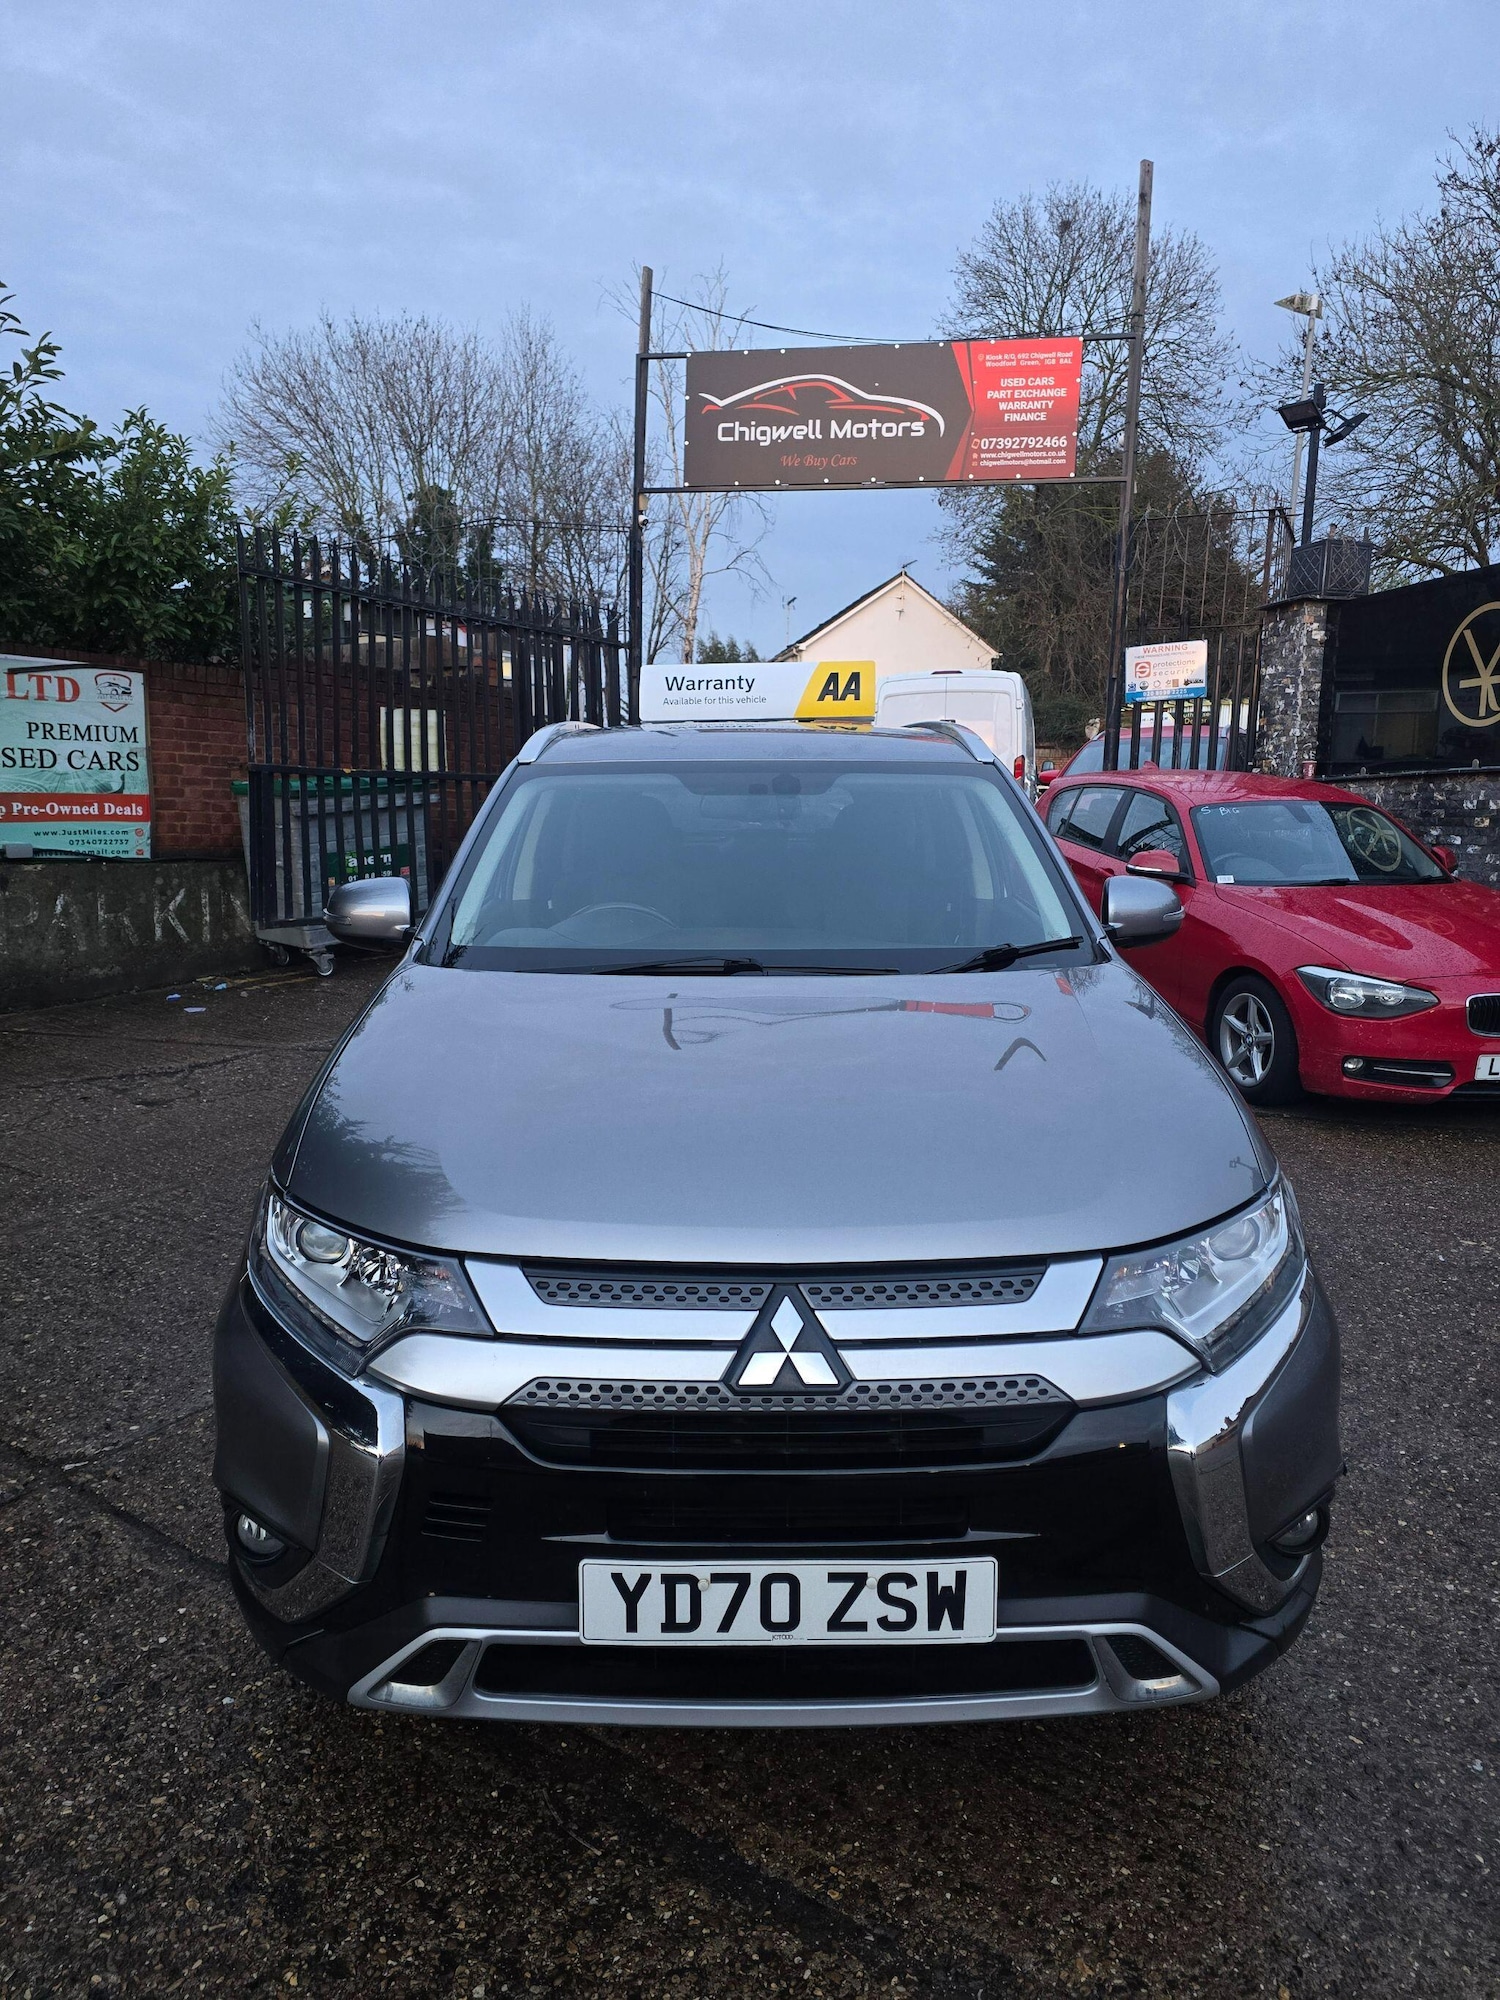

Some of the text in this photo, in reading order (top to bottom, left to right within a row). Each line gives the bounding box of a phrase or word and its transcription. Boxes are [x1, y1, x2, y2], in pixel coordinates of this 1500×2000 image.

[1001, 377, 1055, 387] USED CARS
[987, 388, 1067, 399] PART EXCHANGE
[999, 400, 1054, 410] WARRANTY
[1005, 412, 1047, 422] FINANCE
[717, 418, 925, 446] Chigwell Motors
[981, 436, 1067, 449] 07392792466
[981, 450, 1066, 459] www.chigwellmotors.co.uk
[780, 454, 858, 470] We Buy Cars
[980, 459, 1066, 467] chigwellmotors@hotmail.com
[1143, 644, 1188, 654] WARNING
[1153, 659, 1196, 669] protections
[1153, 668, 1196, 677] security
[6, 672, 80, 702] LTD
[665, 675, 755, 692] Warranty
[817, 671, 861, 702] AA
[663, 694, 767, 706] Available for this vehicle
[26, 721, 139, 744] PREMIUM
[67, 750, 140, 772] CARS
[11, 801, 99, 816] Pre-Owned
[103, 803, 143, 816] Deals
[34, 829, 129, 837] www.JustMiles.com
[611, 1569, 967, 1633] YD70 ZSW
